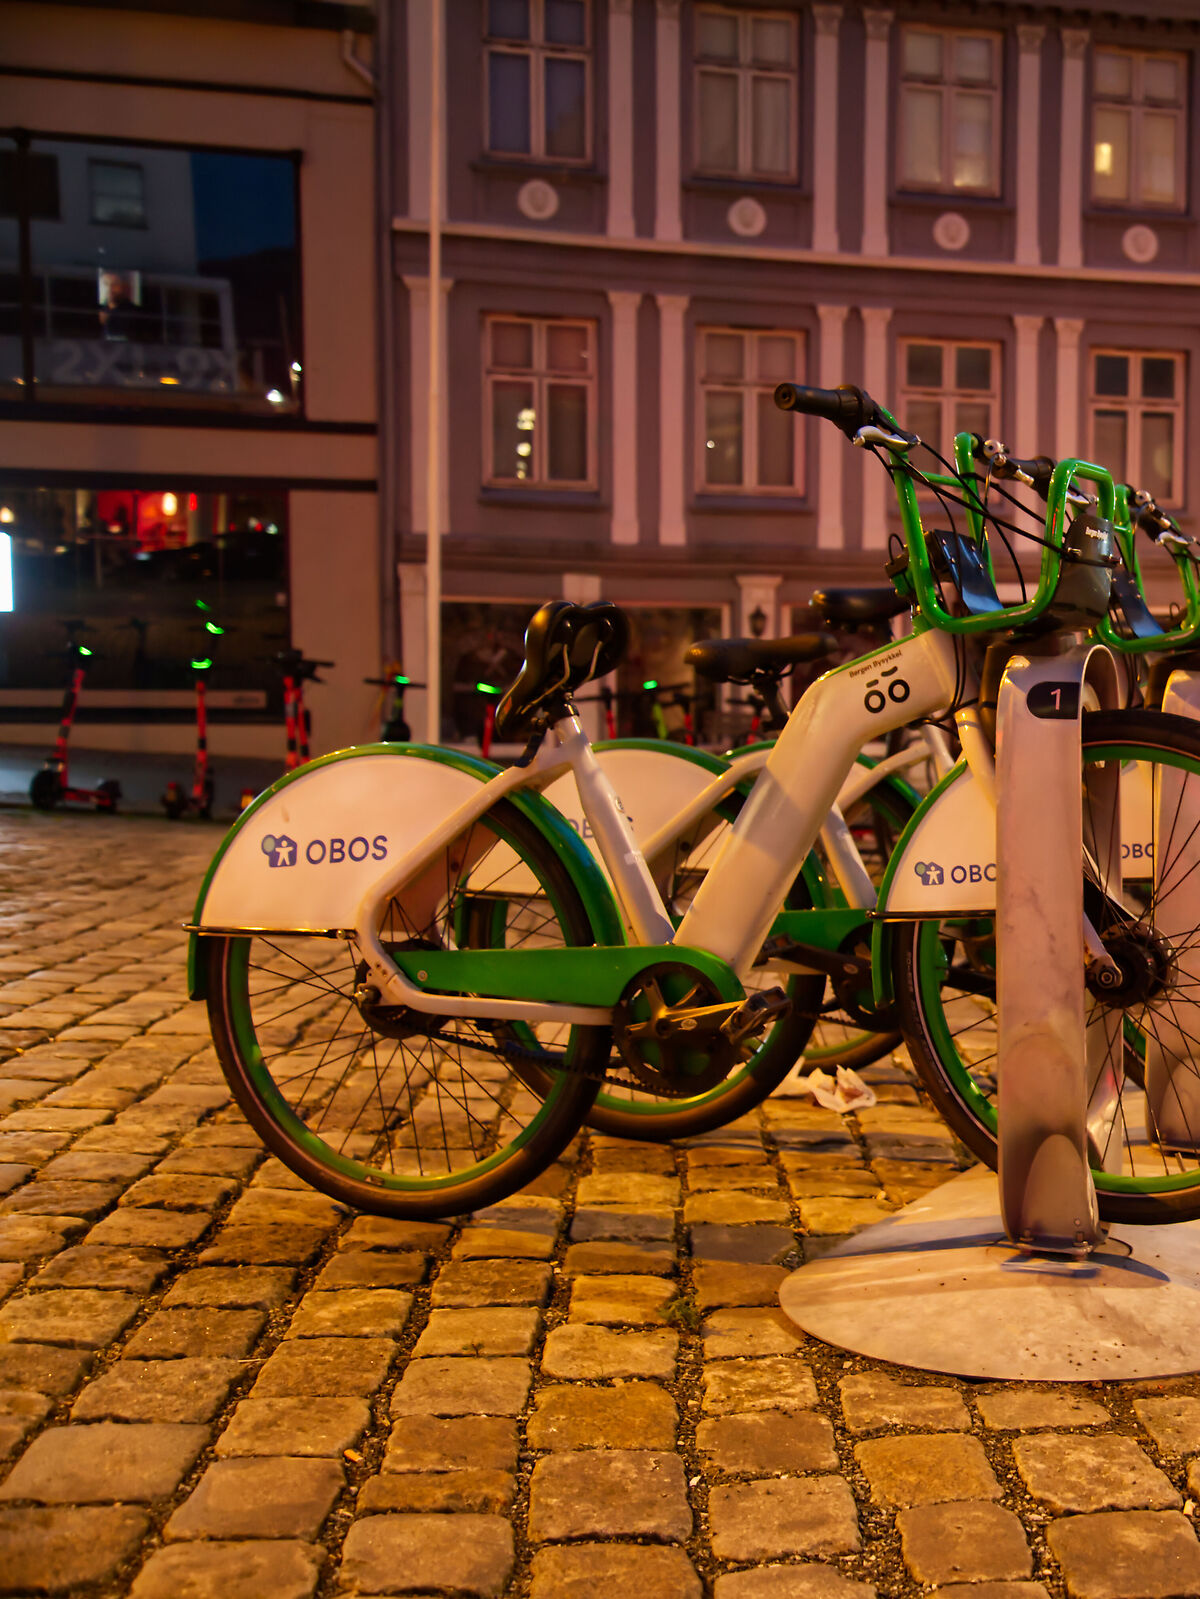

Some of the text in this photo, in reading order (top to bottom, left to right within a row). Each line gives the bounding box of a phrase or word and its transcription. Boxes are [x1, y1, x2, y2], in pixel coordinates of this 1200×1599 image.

[848, 649, 902, 678] Bergen Bysykkel
[1050, 688, 1061, 711] 1
[306, 835, 388, 865] OBOS
